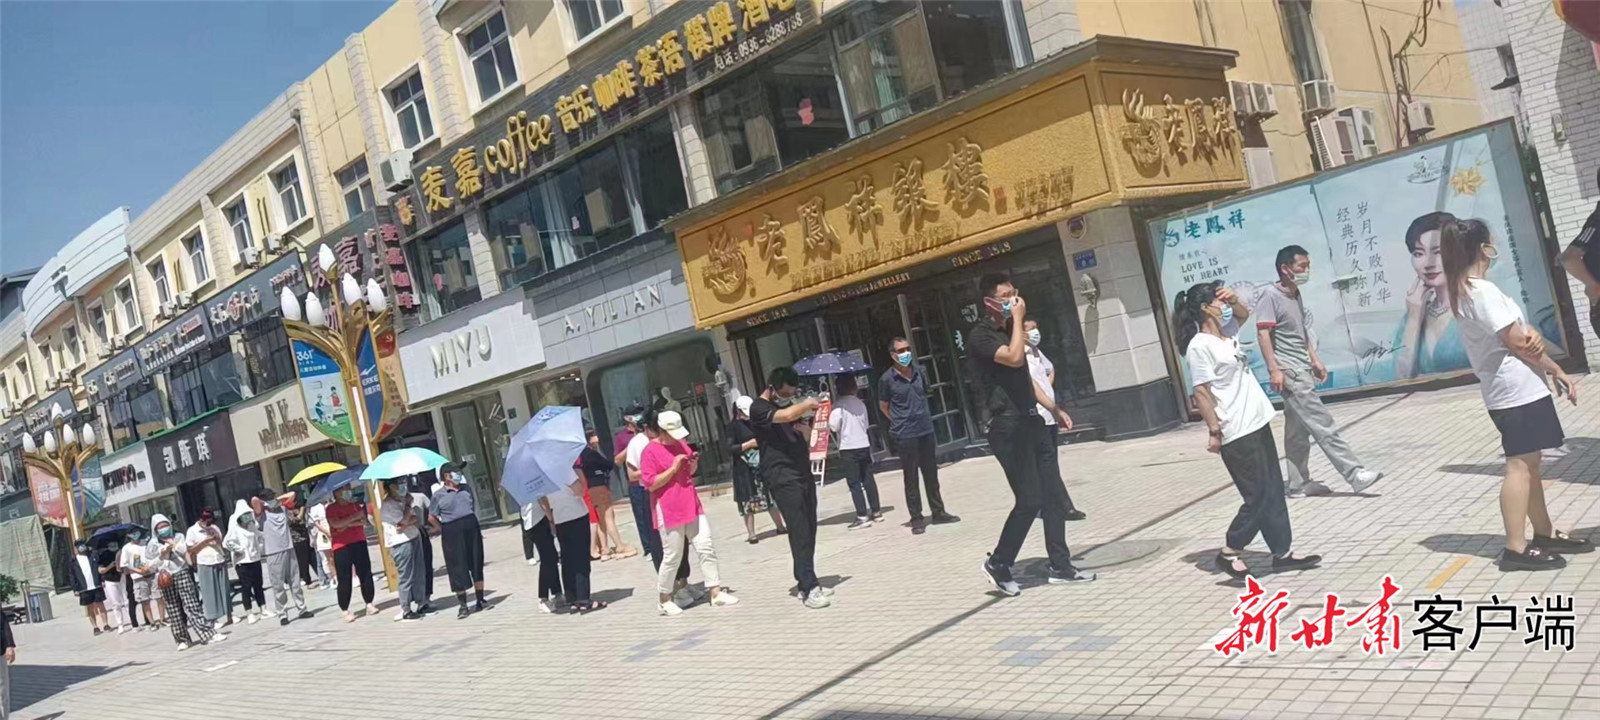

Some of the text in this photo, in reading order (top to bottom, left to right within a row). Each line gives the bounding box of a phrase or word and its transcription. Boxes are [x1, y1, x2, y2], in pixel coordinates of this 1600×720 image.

[420, 145, 483, 214] 麦嘉
[484, 110, 553, 174] coffee
[555, 84, 597, 134] 音乐
[592, 60, 639, 112] 咖啡
[635, 30, 687, 88] 茶语
[684, 1, 738, 61] 棋牌
[952, 250, 982, 267] SINCE
[1181, 257, 1219, 274] LOVE IS
[1183, 266, 1229, 284] MY HEART
[1337, 207, 1372, 308] 经典历久弥新
[1357, 201, 1392, 304] 岁月不败风华
[585, 283, 663, 330] YILIAN
[429, 324, 494, 378] MIYU
[361, 374, 379, 386] ERKE
